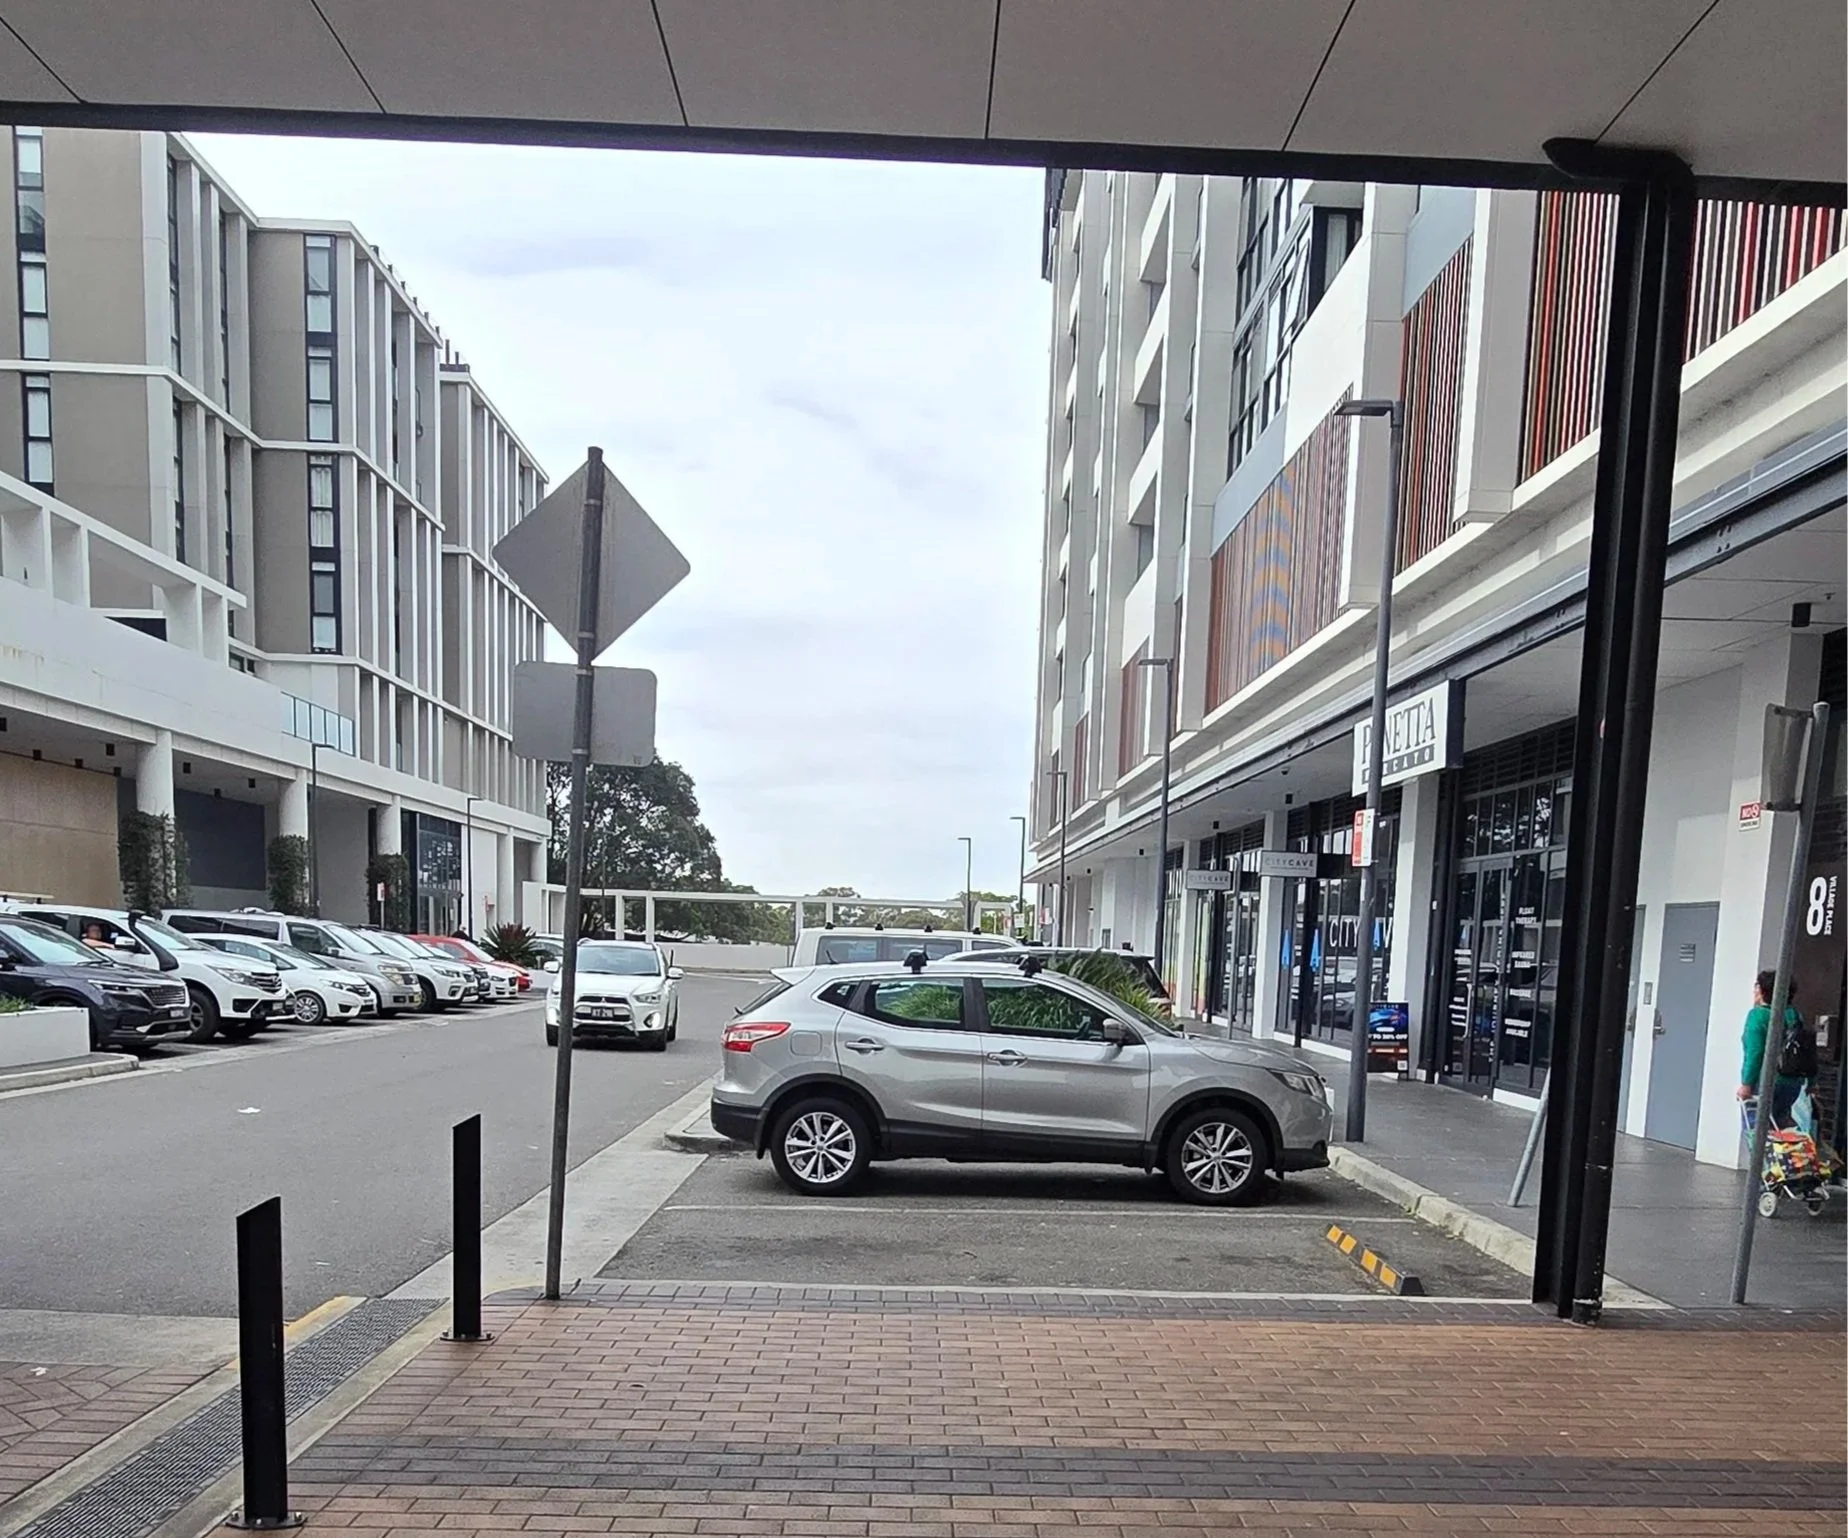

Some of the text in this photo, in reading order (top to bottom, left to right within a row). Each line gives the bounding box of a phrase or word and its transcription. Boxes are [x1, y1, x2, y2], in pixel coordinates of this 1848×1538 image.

[1362, 697, 1436, 765] PNETTA
[1806, 876, 1828, 936] 8
[1823, 875, 1838, 935] VILLAGE PLACE
